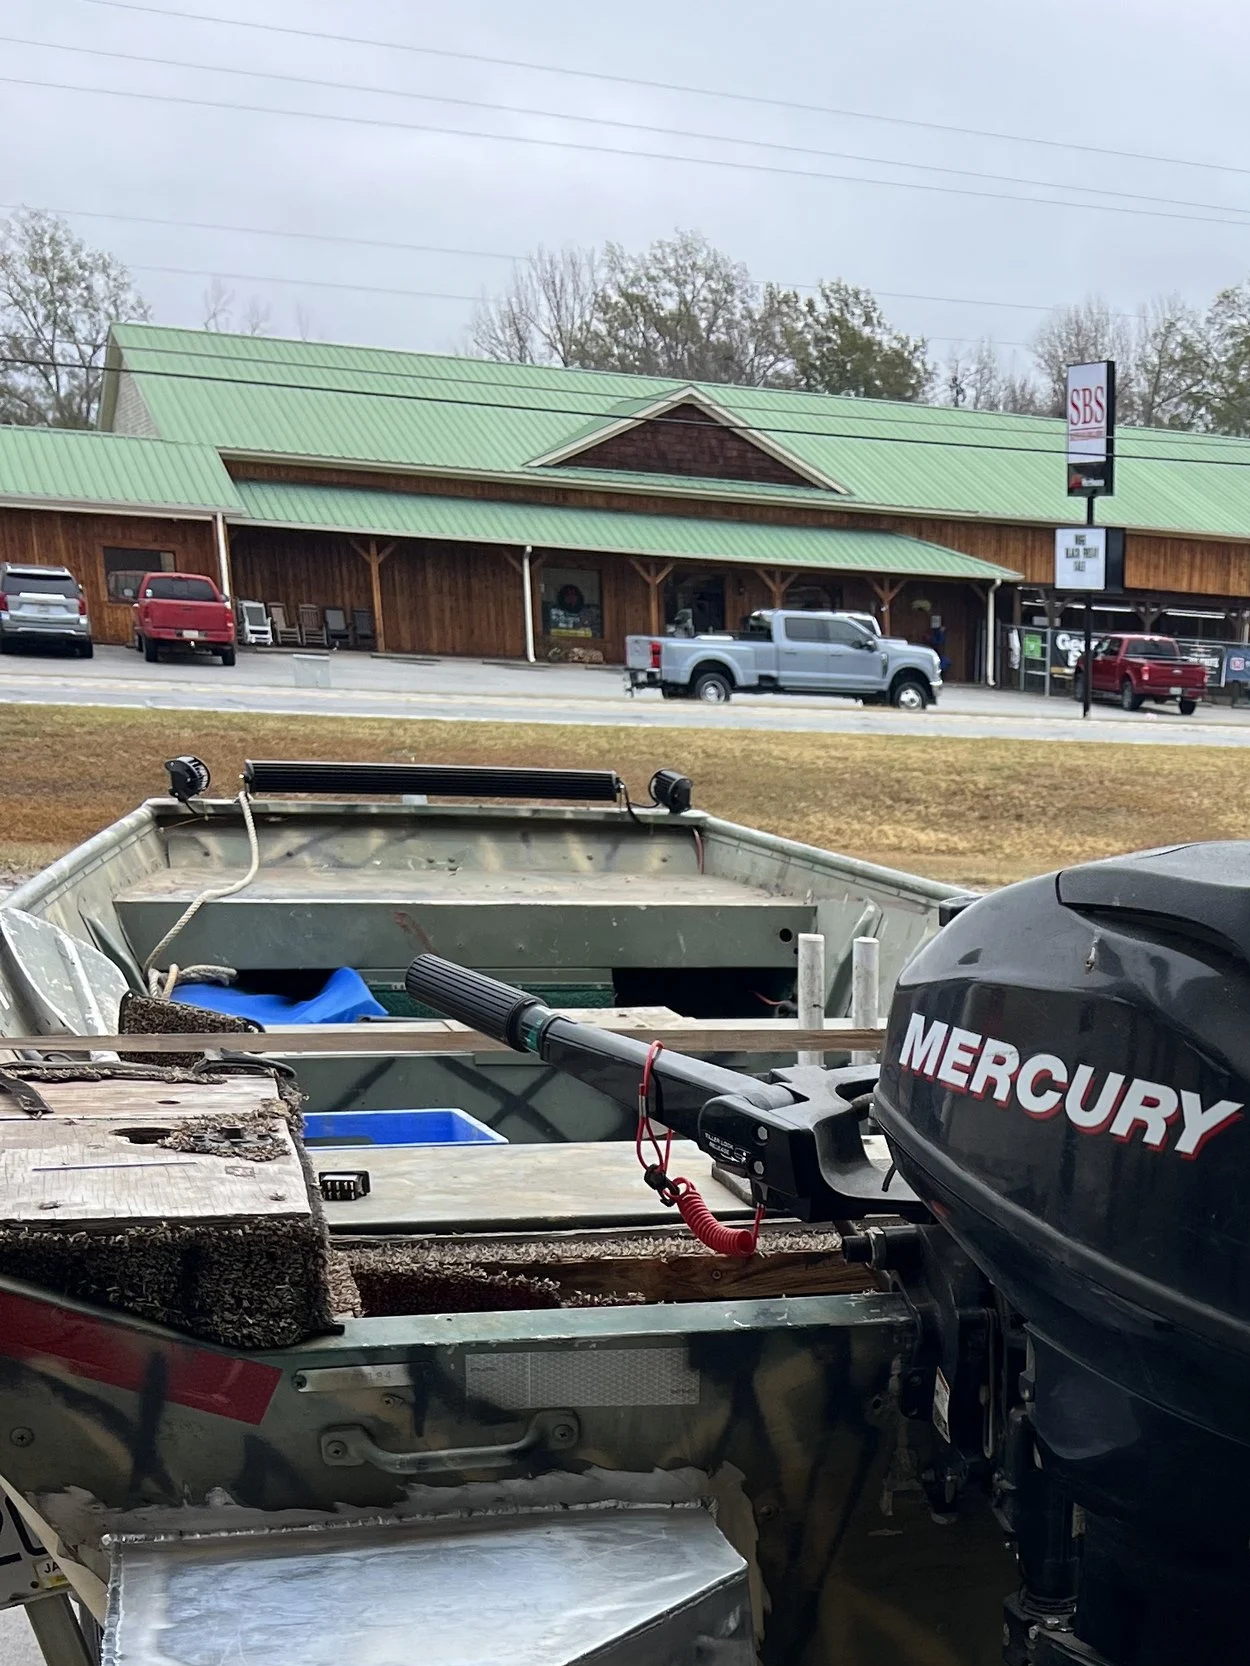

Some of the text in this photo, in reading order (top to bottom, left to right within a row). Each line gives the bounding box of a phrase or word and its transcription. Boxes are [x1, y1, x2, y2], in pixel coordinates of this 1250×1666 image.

[1070, 386, 1105, 426] SBS
[899, 1012, 1244, 1161] MERCURY
[44, 1561, 61, 1574] JA
